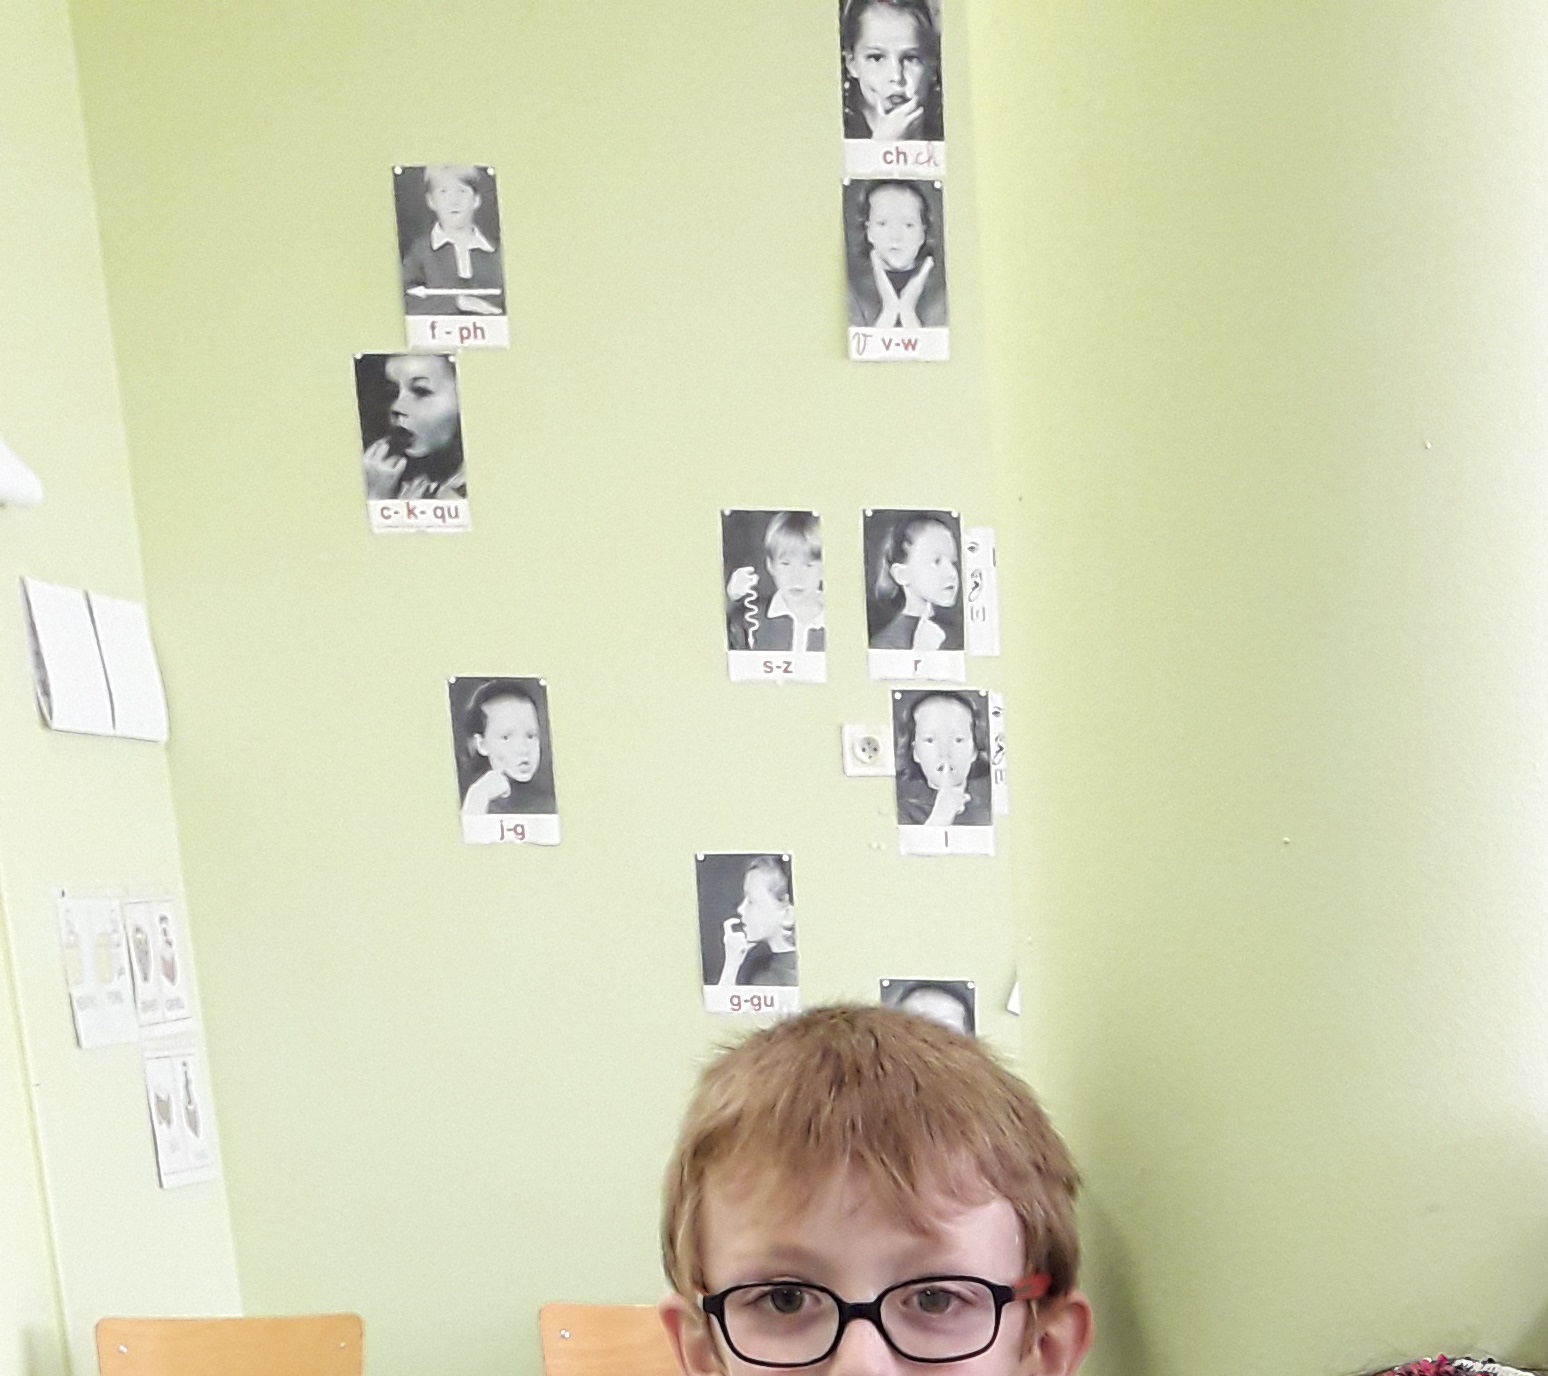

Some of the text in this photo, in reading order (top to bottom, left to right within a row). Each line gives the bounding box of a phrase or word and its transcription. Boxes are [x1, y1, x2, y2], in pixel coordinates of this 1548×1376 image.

[883, 146, 907, 165] ch
[429, 320, 437, 339] f
[459, 322, 485, 344] ph
[881, 338, 918, 351] v-w
[433, 505, 459, 523] qu
[763, 657, 793, 674] s-z
[913, 656, 923, 672] r
[500, 820, 525, 841] j-g
[730, 995, 774, 1011] g-gu
